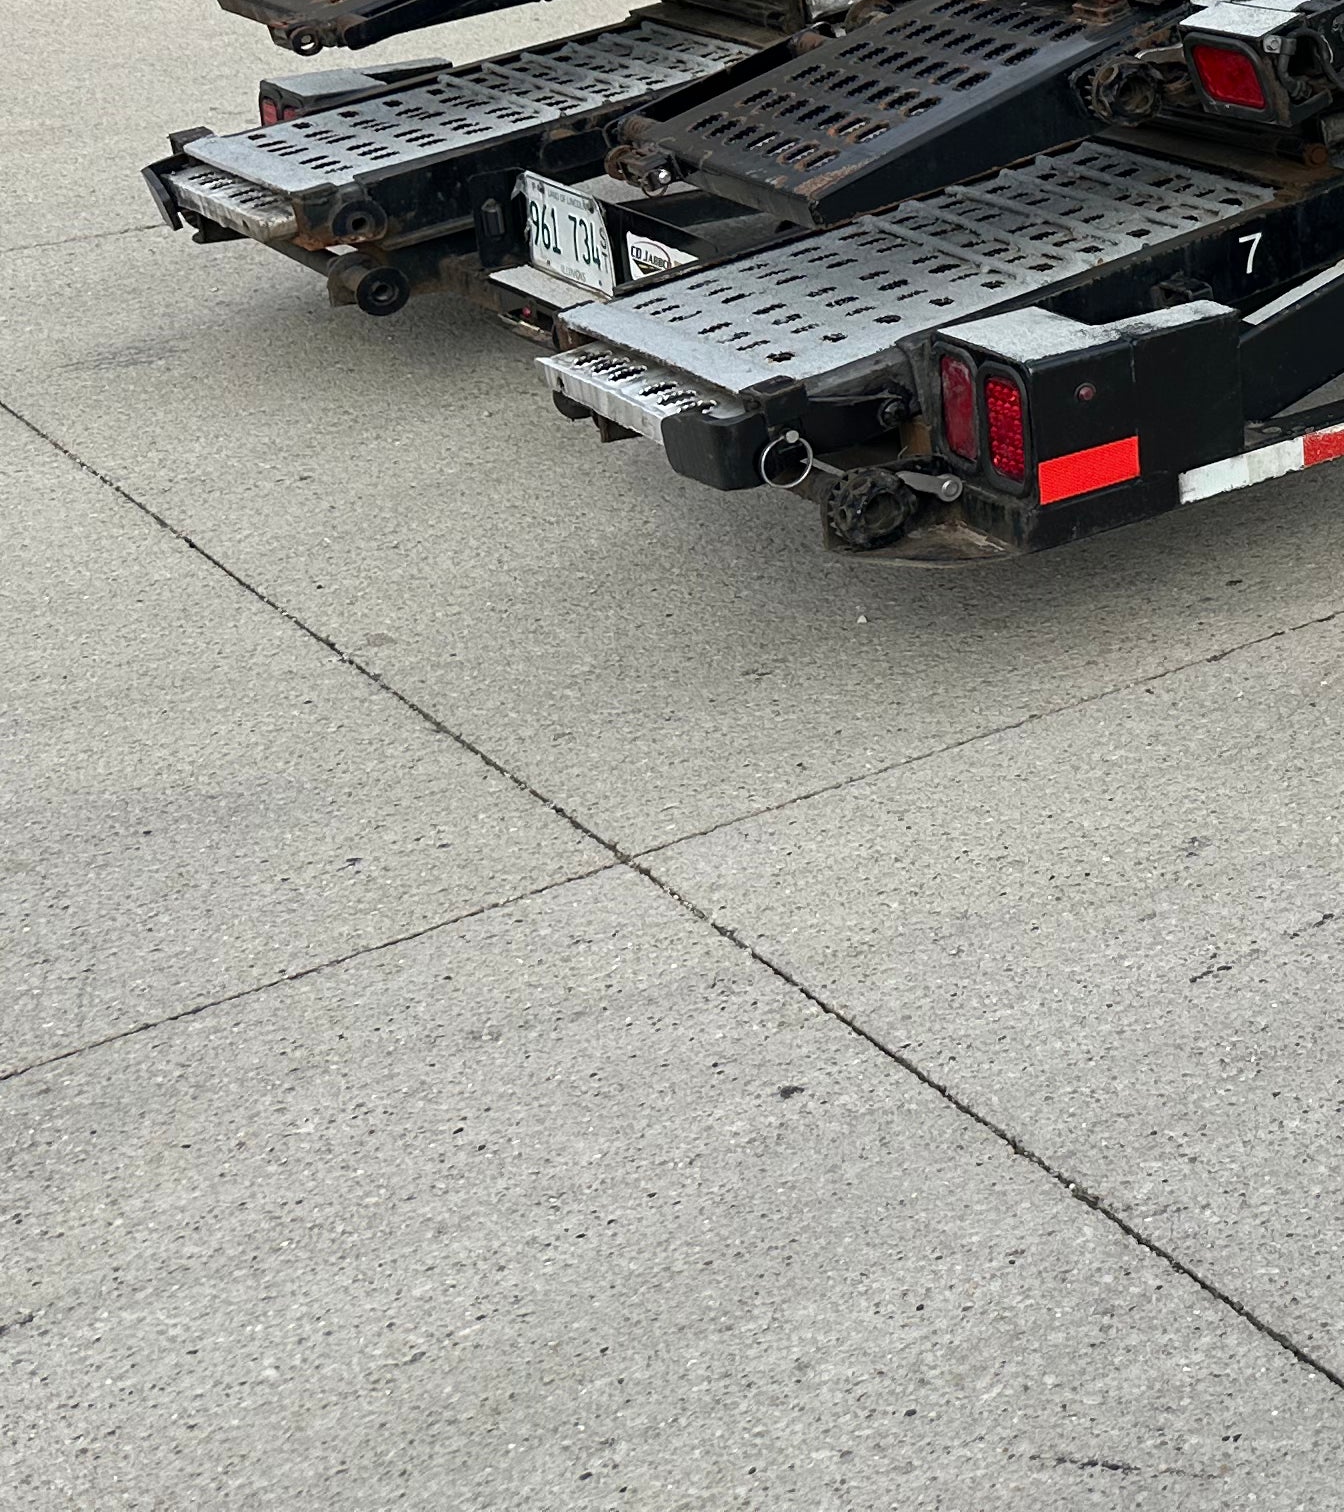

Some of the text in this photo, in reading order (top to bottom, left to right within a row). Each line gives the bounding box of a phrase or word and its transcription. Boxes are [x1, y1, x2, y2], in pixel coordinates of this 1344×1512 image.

[530, 200, 601, 271] 961 734
[1239, 232, 1262, 274] 7
